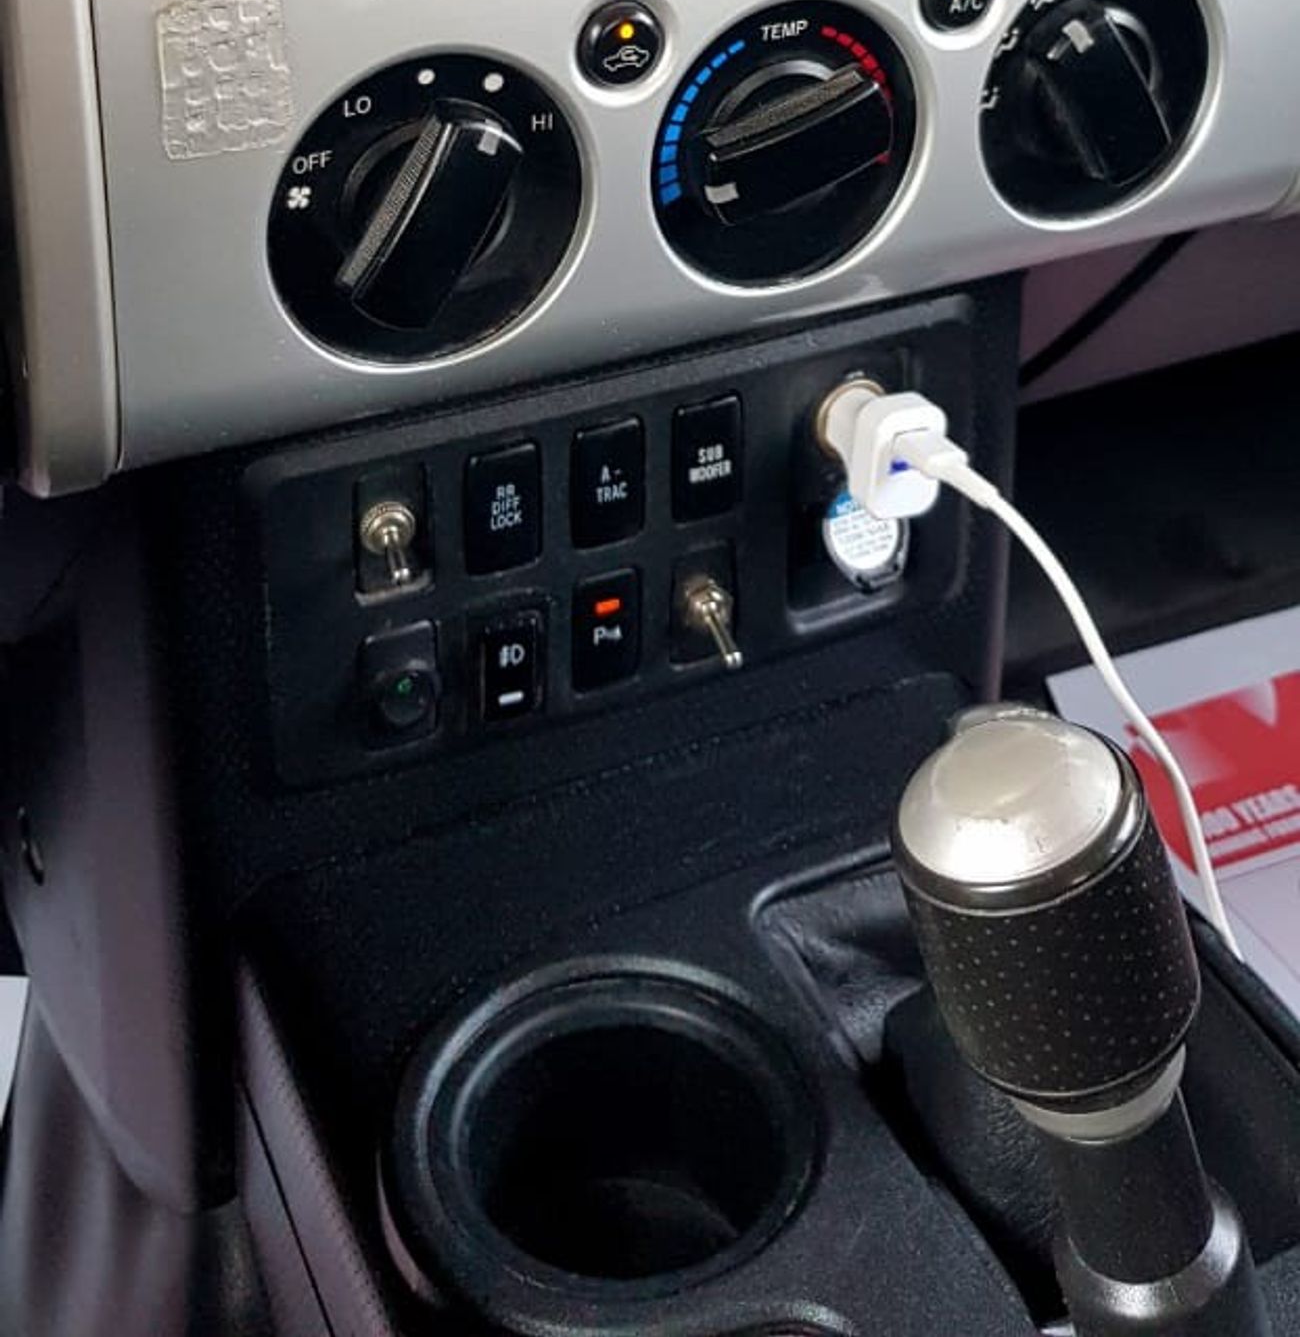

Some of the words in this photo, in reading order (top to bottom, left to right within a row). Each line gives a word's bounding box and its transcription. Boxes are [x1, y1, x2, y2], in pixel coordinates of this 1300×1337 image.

[761, 20, 809, 41] TEMP
[344, 95, 372, 118] LO
[531, 113, 553, 132] HI
[292, 150, 333, 175] OFF
[698, 444, 723, 464] SUB
[688, 459, 732, 485] WOOFER
[596, 481, 628, 504] TRAC
[491, 498, 520, 516] DIFF
[490, 511, 522, 532] LOCK
